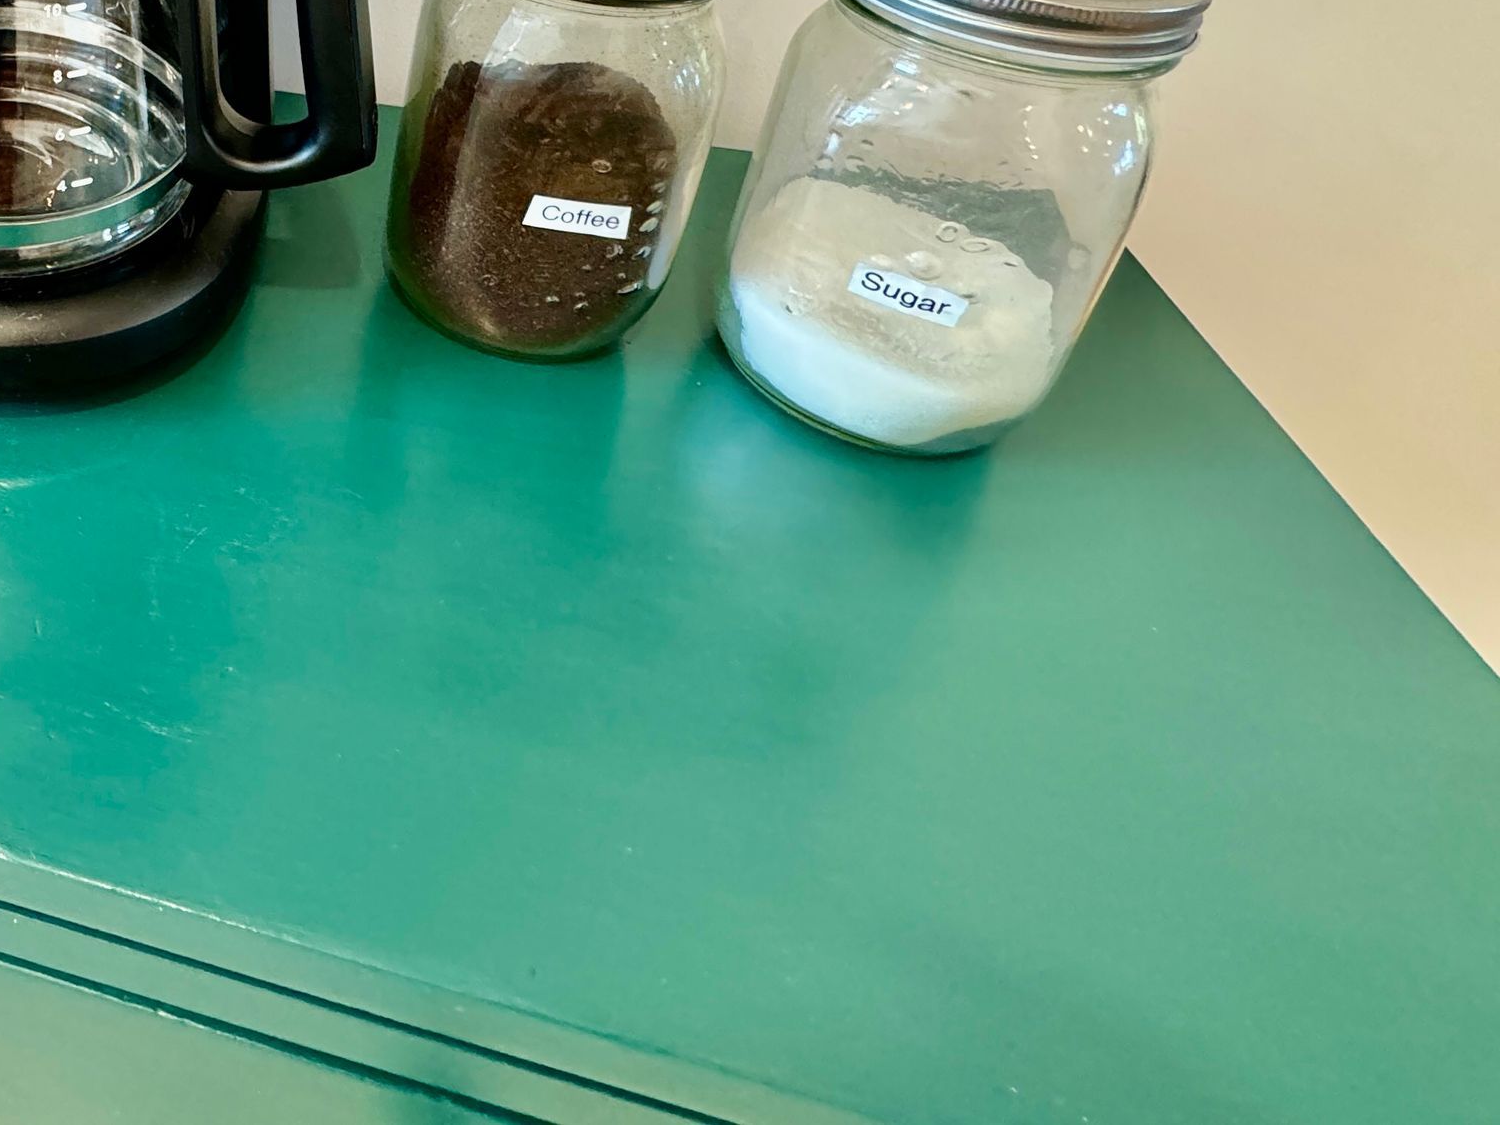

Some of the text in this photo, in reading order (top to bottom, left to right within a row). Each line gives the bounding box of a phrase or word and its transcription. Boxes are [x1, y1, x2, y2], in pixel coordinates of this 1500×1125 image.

[43, 2, 62, 18] 10
[53, 69, 63, 84] 8
[55, 128, 65, 142] 6
[56, 180, 68, 193] 4
[541, 204, 620, 230] Coffee
[860, 271, 952, 315] Sugar
